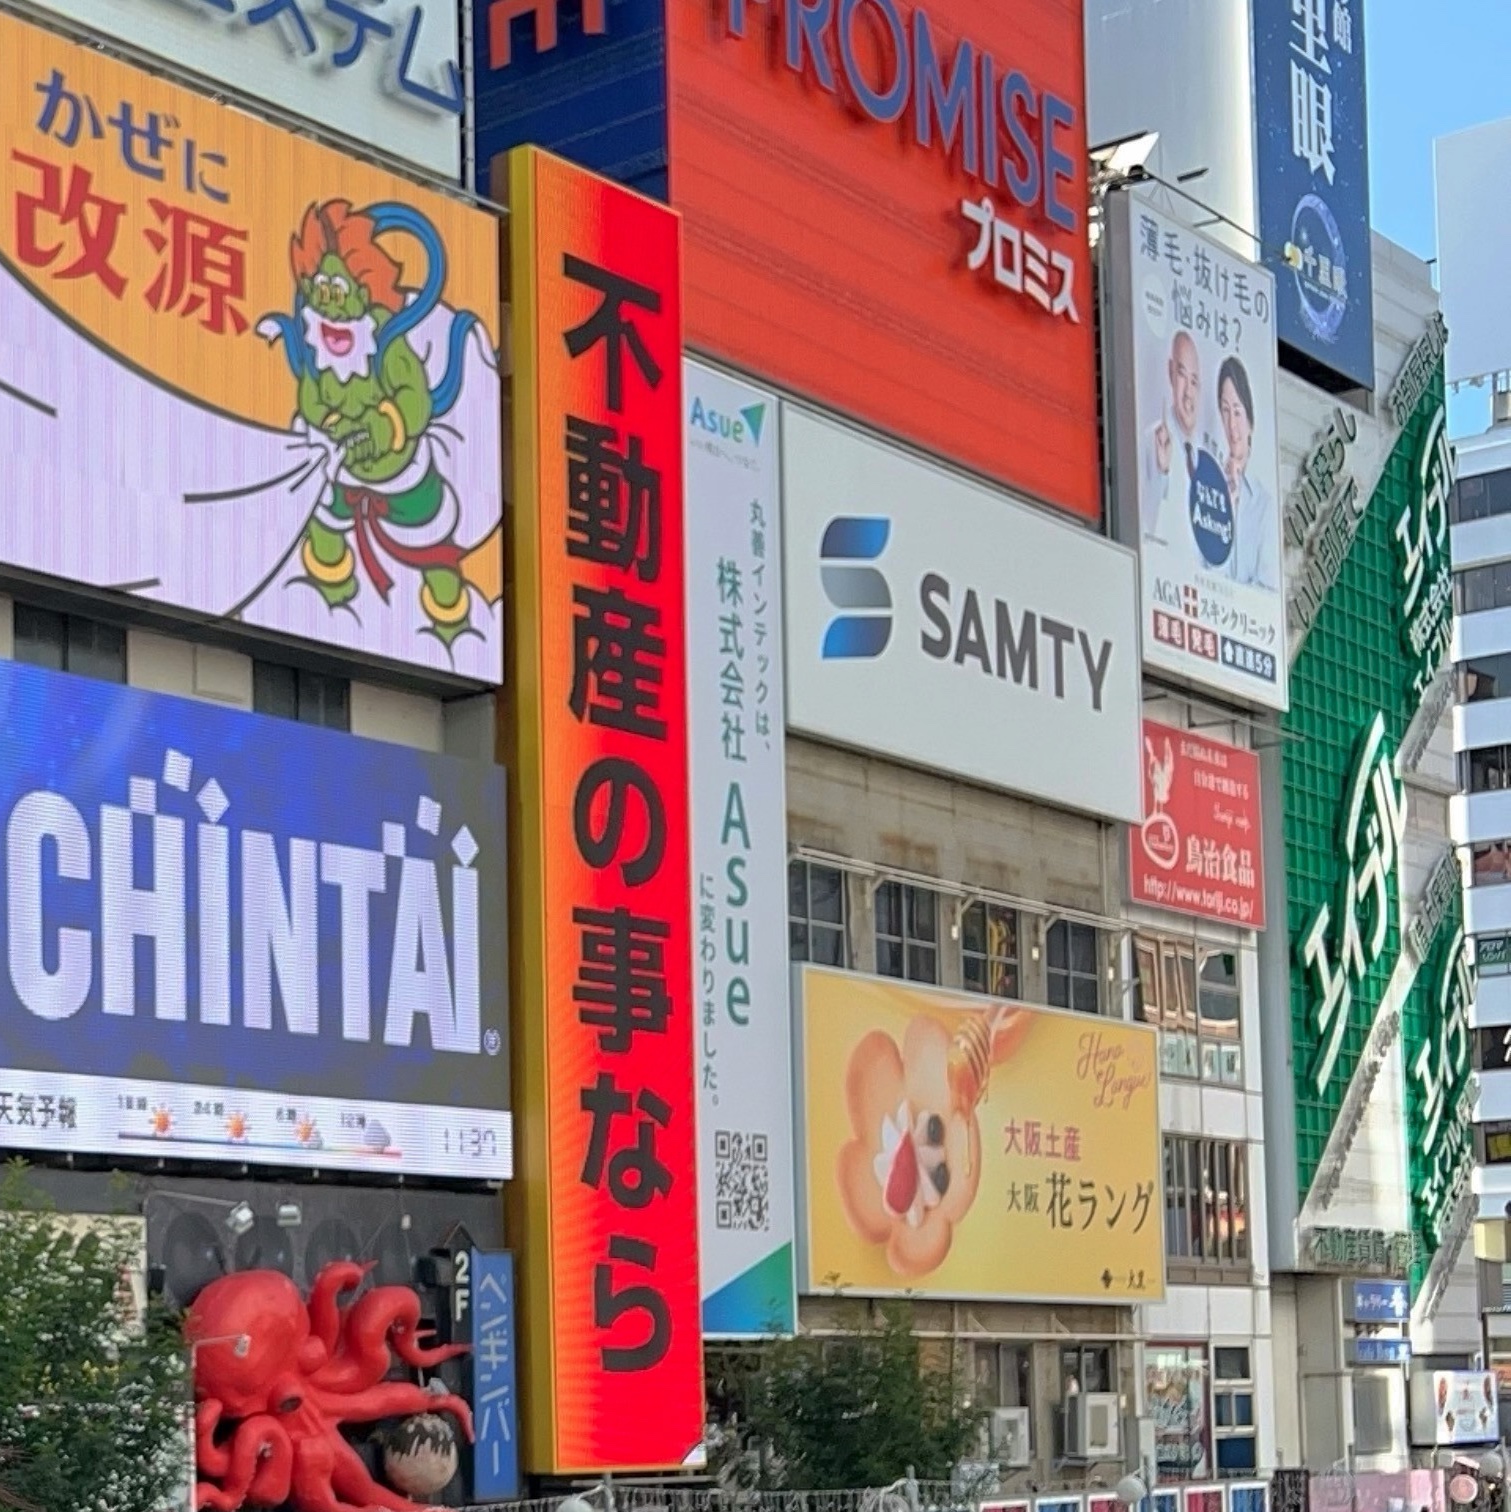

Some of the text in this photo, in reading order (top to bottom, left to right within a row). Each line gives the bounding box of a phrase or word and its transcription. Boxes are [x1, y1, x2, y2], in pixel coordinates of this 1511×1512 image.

[35, 68, 229, 203] かぜに
[10, 148, 251, 336] 改源
[961, 198, 1080, 323] プロミス
[690, 396, 744, 444] Asue
[920, 570, 1113, 713] SAMTY
[561, 252, 674, 1374] 不動産の事なら
[718, 555, 752, 1027] 株式会社 Asue
[1304, 735, 1407, 1060] エイブル
[698, 874, 719, 1105] に変わりました。
[1004, 1117, 1081, 1161] 大阪土産
[1006, 1170, 1155, 1235] 大阪 花ラング
[479, 1272, 512, 1477] ペンギンバー
